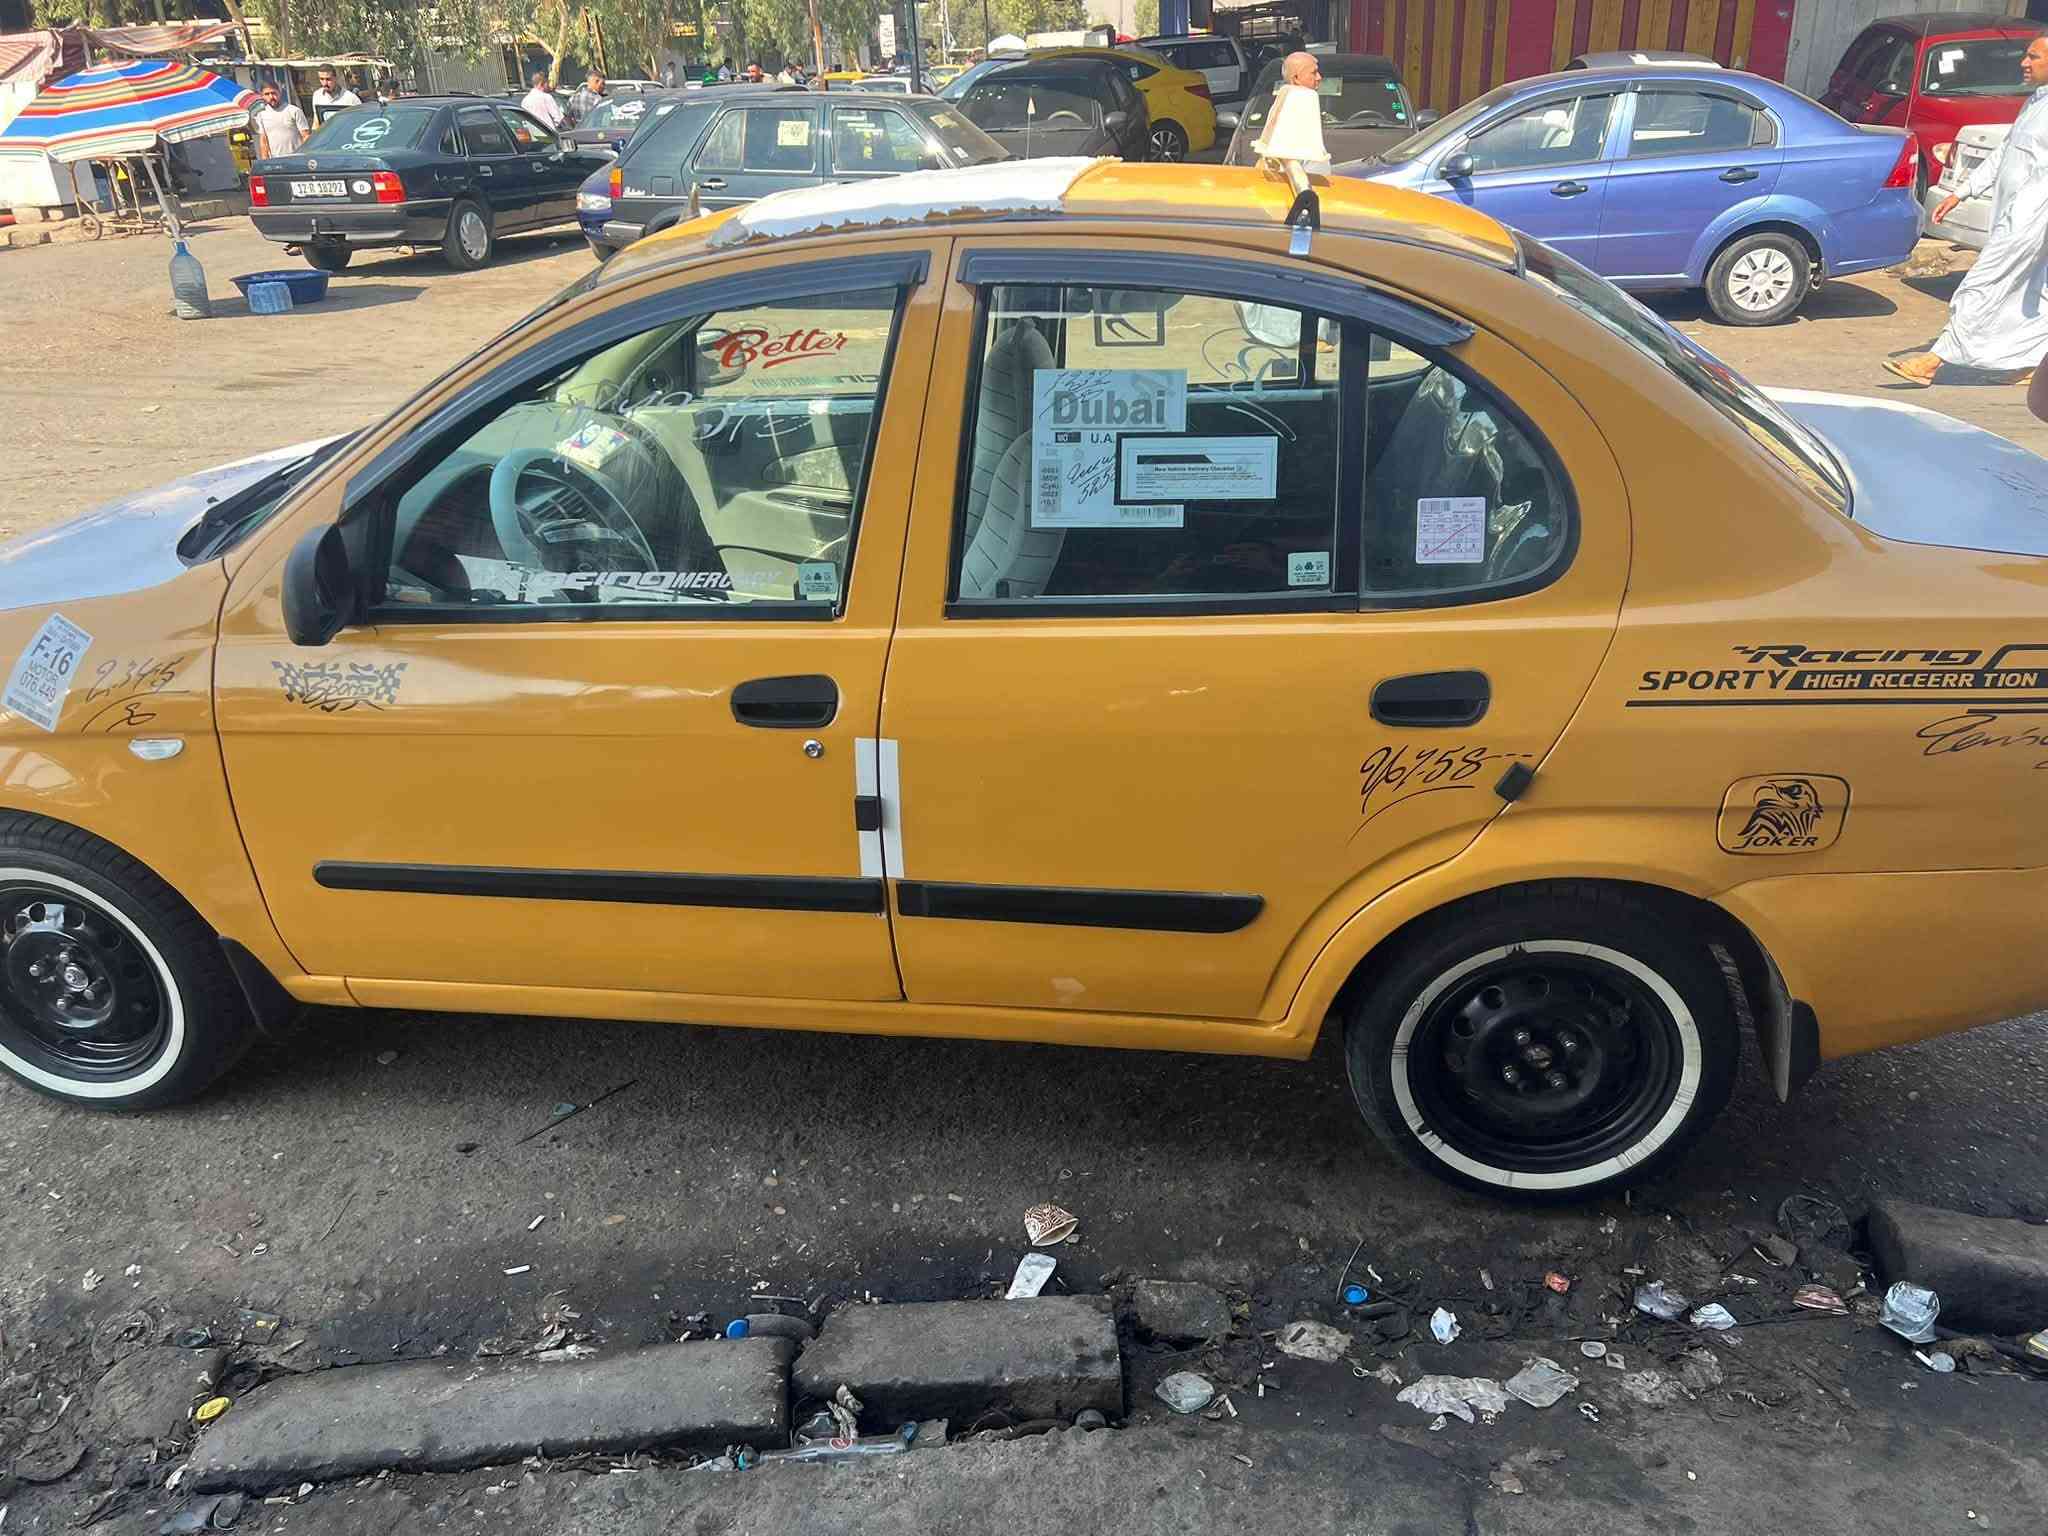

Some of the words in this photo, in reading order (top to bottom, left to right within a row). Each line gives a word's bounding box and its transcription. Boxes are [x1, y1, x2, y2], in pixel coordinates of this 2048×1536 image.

[713, 328, 848, 369] Better
[1053, 390, 1166, 425] Dubai
[1744, 644, 1984, 667] Racing
[1638, 669, 1790, 691] SPORTY
[1802, 671, 1861, 689] HIGH
[1732, 834, 1818, 850] JOKER
